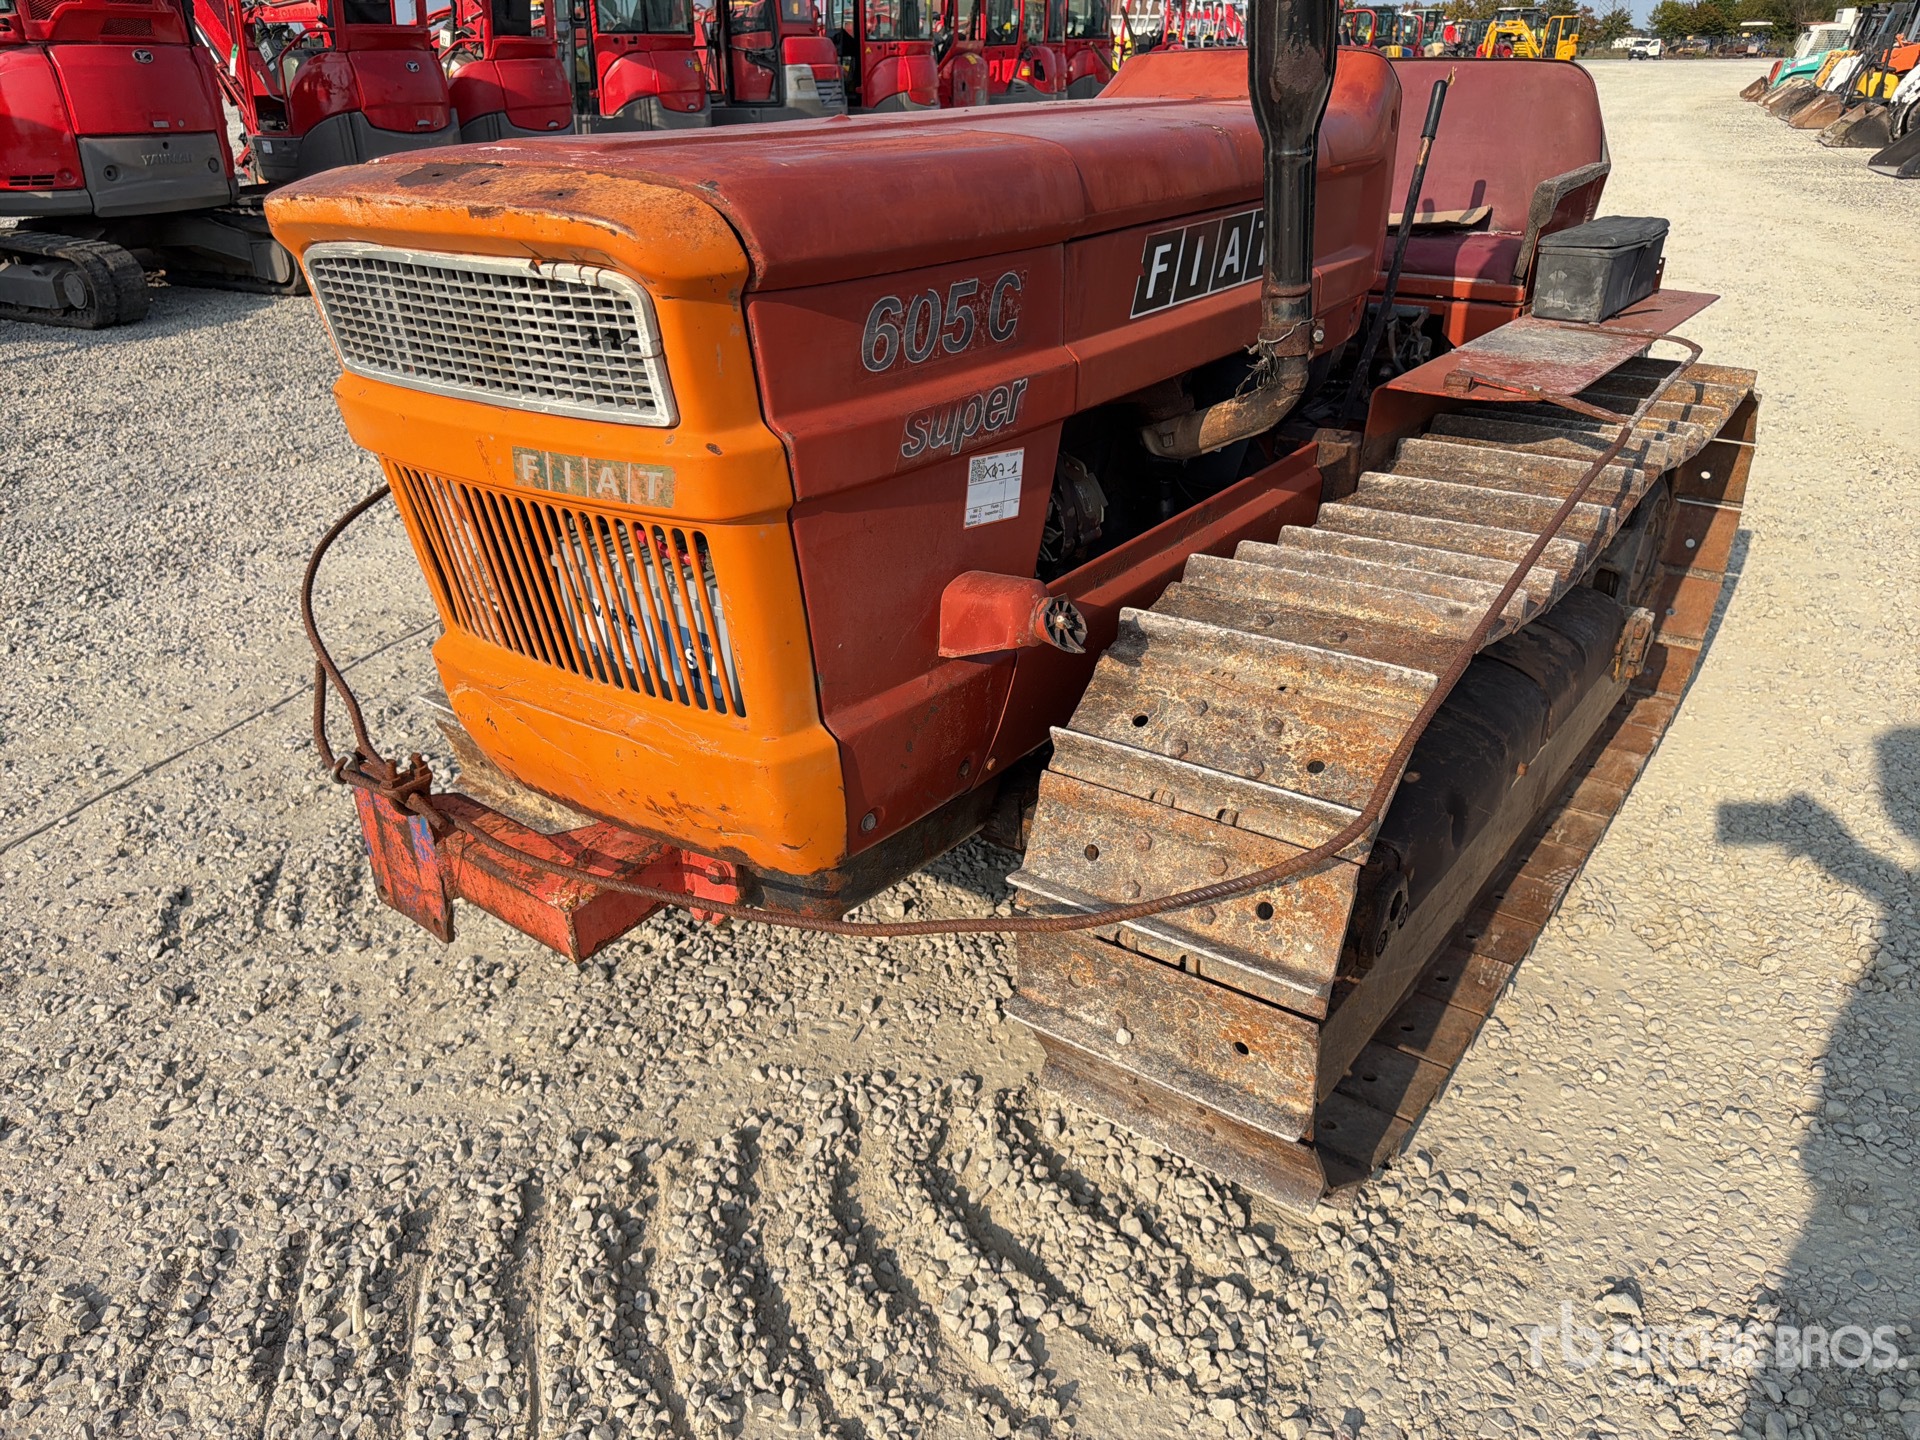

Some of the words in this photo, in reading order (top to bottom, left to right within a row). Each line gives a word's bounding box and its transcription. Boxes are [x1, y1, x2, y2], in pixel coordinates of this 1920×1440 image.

[861, 277, 979, 373] 605
[989, 271, 1022, 342] C
[901, 377, 1029, 458] super
[519, 453, 664, 501] FIAT
[591, 601, 639, 630] VRA
